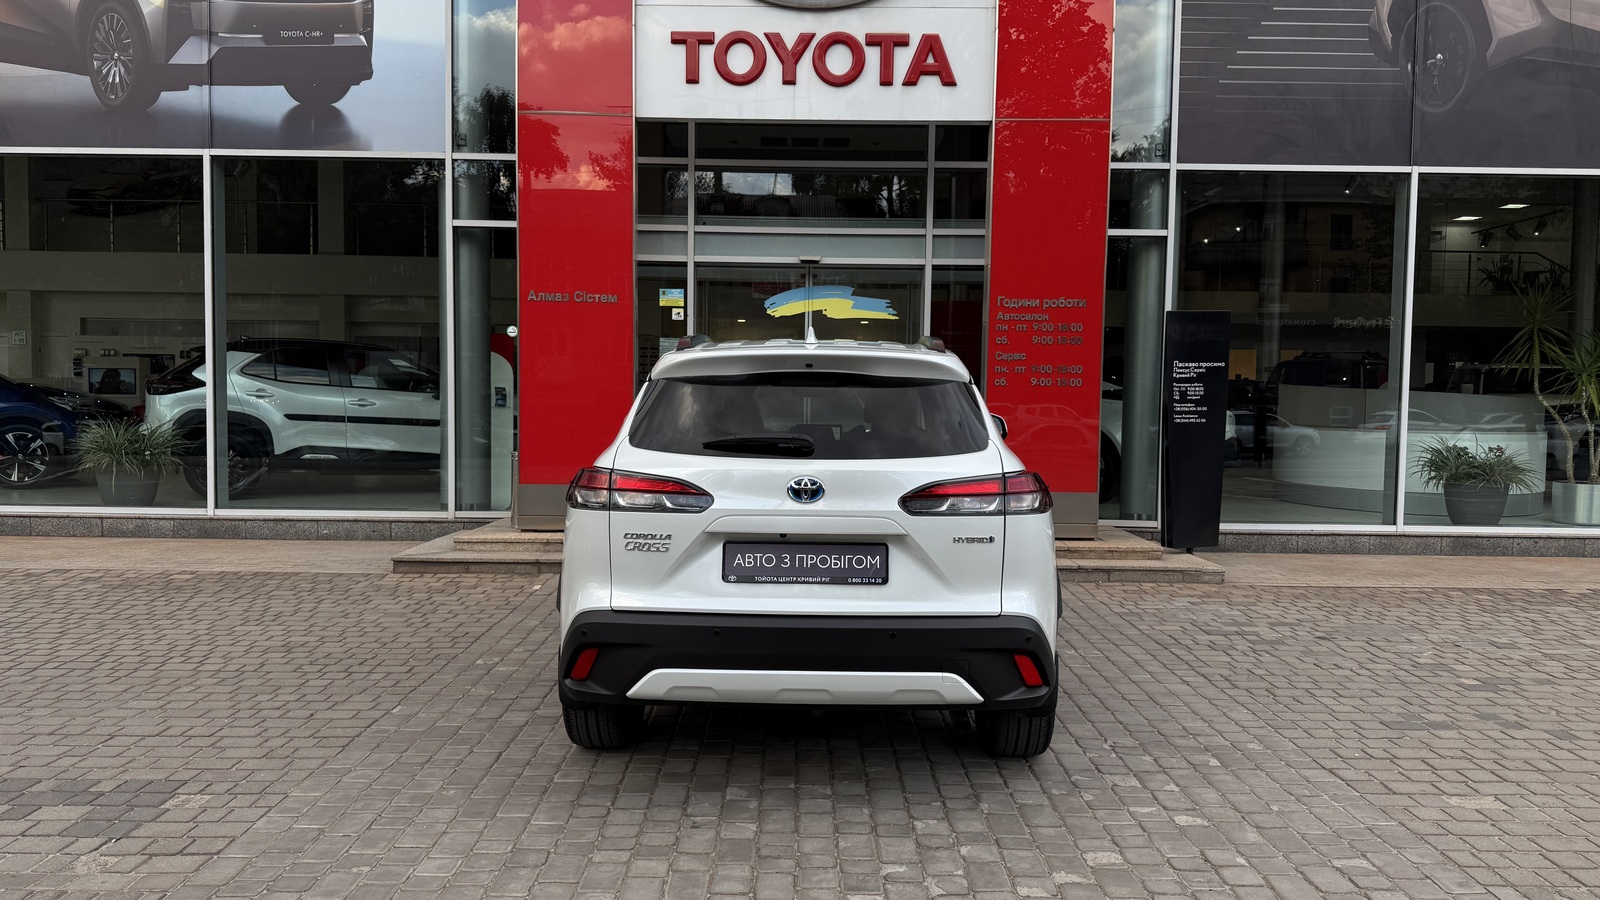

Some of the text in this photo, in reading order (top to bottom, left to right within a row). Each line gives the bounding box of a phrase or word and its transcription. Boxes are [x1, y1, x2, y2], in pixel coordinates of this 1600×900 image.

[670, 30, 957, 87] TOYOTA
[528, 290, 618, 303] Алмаз Сістем
[997, 296, 1087, 309] Години роботи
[996, 311, 1049, 321] Автосалон
[995, 336, 1010, 344] сб.
[995, 351, 1027, 361] Сервіс
[994, 377, 1009, 386] сб.
[623, 532, 672, 540] COROLLA
[952, 535, 990, 544] HYBRID
[624, 540, 671, 552] CROSS
[733, 553, 776, 567] АВТО
[795, 554, 880, 569] ПРОБІГОМ
